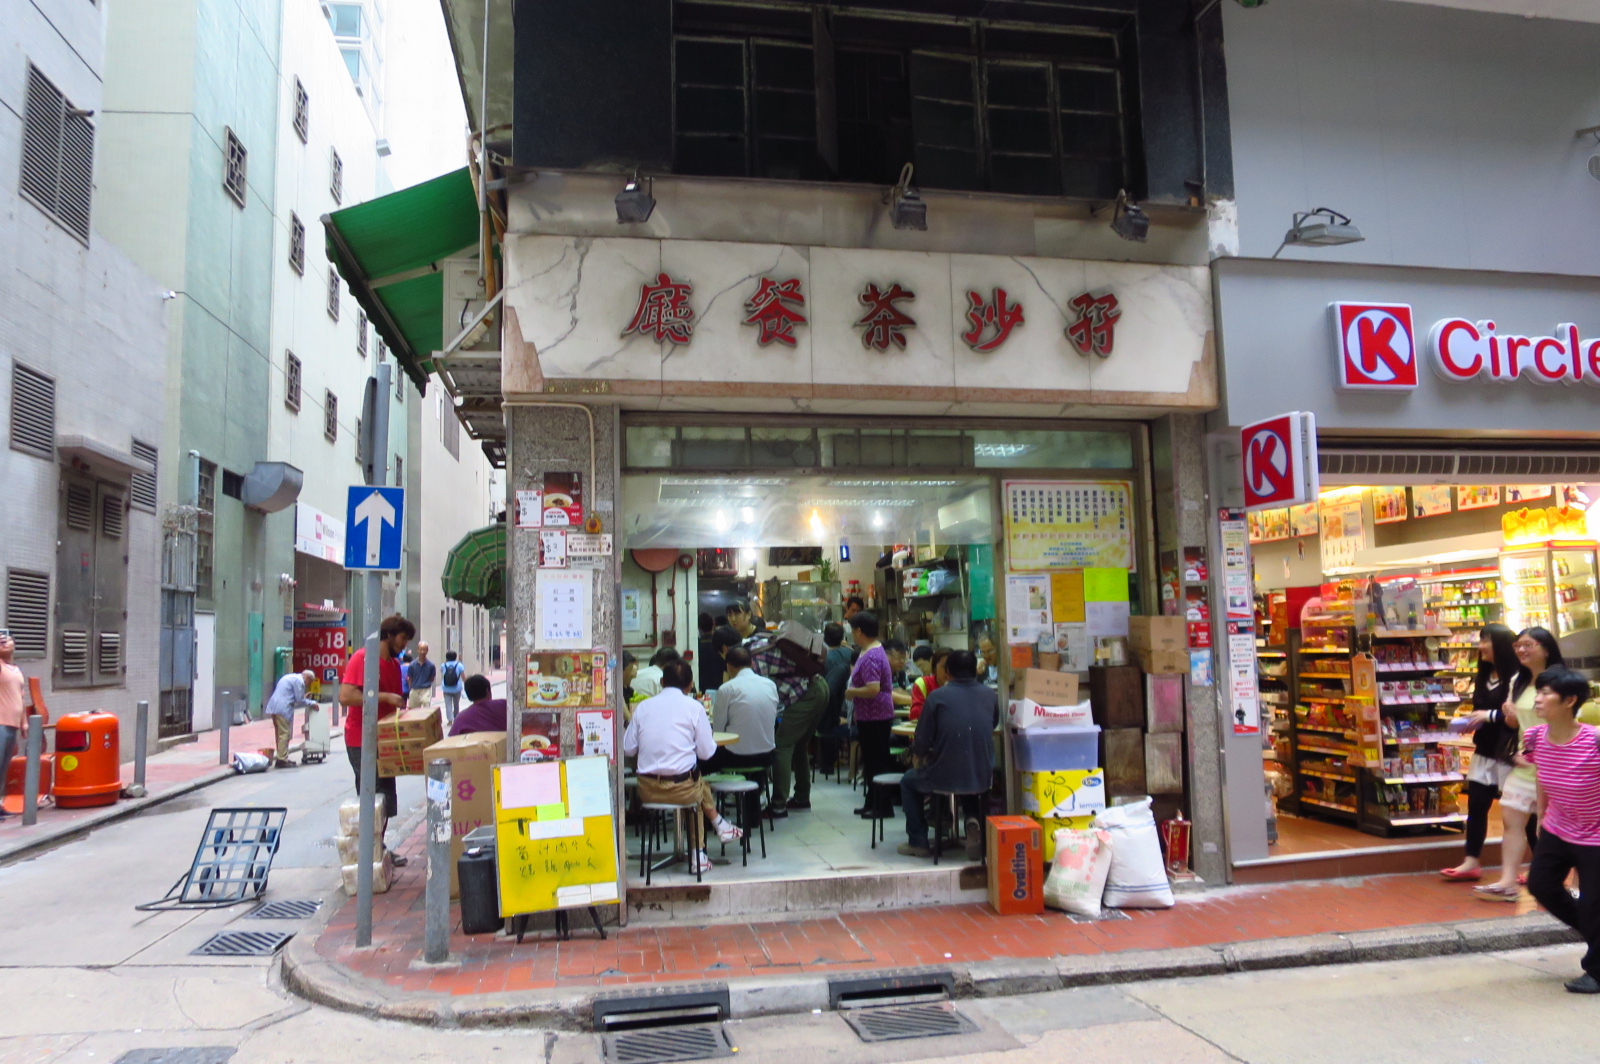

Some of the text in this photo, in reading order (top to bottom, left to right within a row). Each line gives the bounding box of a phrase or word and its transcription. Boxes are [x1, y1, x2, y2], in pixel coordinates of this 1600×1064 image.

[620, 272, 1122, 359] 孖沙茶餐廳
[1033, 706, 1070, 718] Macaroni
[1010, 842, 1027, 900] Ovaltine
